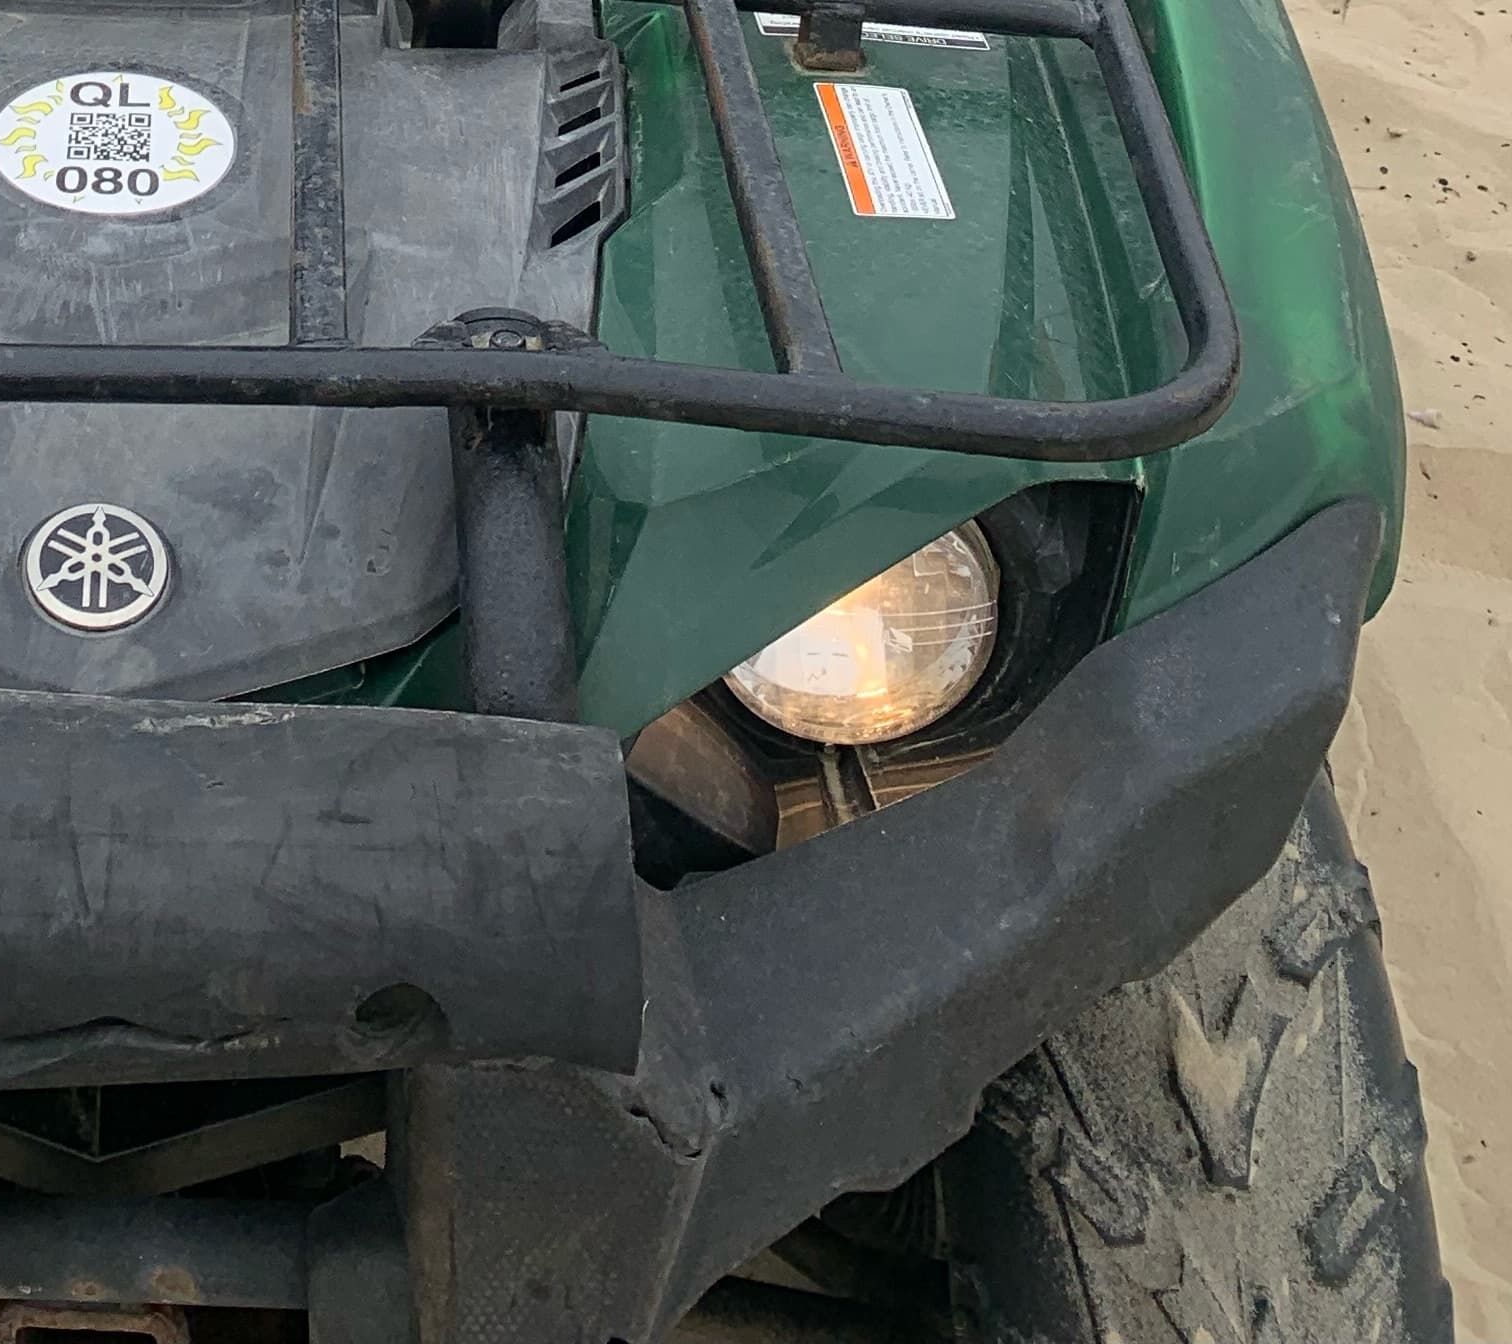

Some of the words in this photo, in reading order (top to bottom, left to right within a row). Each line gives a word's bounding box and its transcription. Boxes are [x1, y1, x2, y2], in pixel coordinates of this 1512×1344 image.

[862, 31, 903, 42] SELEC
[70, 81, 150, 107] QL
[56, 166, 159, 196] 080
